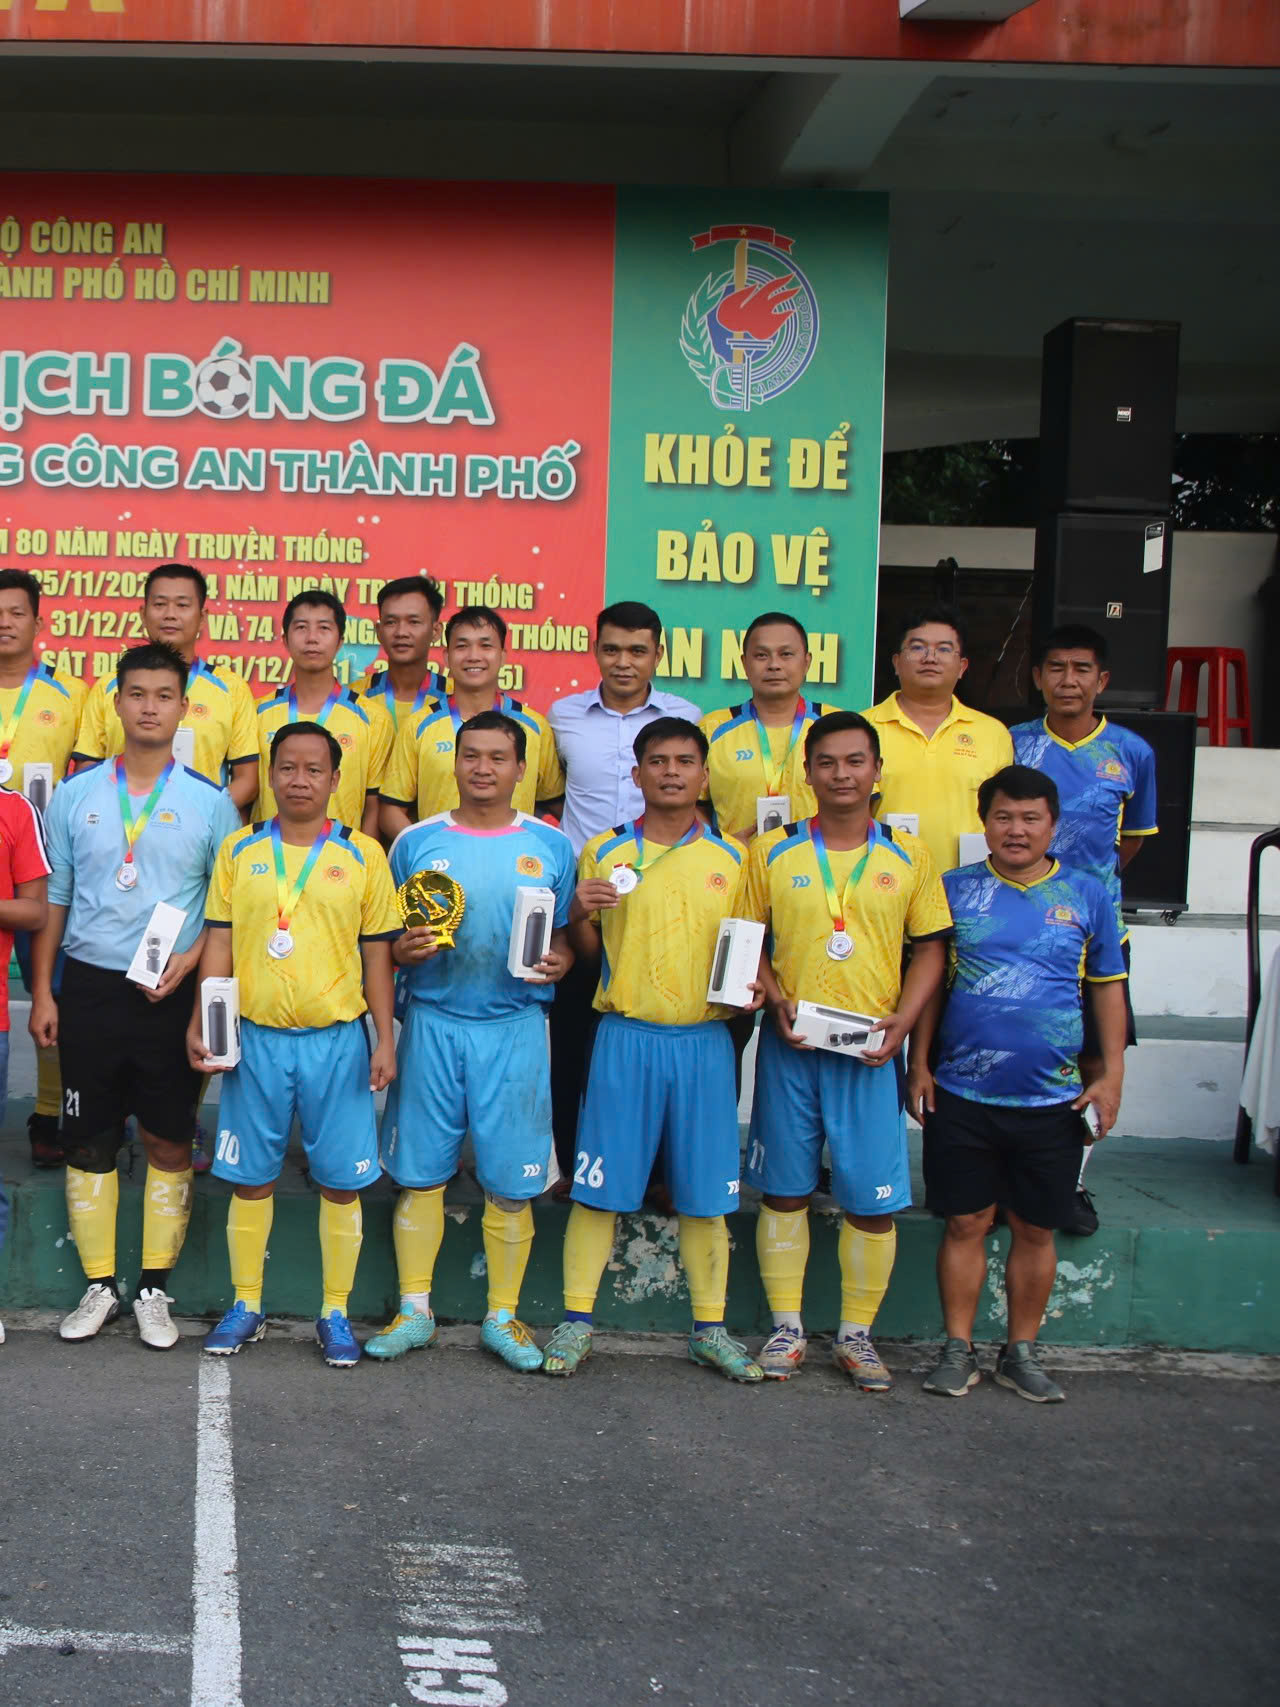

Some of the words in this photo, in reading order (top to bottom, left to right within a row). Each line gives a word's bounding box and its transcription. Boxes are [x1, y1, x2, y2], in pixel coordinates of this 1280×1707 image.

[30, 215, 113, 255] CÔNG
[123, 222, 163, 255] AN
[63, 256, 124, 300] PHỐ
[135, 257, 176, 301] HỒ
[186, 261, 239, 302] CHÍ
[249, 272, 330, 304] MINH
[375, 342, 496, 426] ĐÁ
[32, 432, 178, 489] CÔNG
[186, 446, 266, 492] AN
[270, 440, 457, 496] THÀNH
[465, 440, 581, 501] PHỐ
[644, 422, 771, 488] KHỎE
[787, 421, 851, 491] ĐỂ
[15, 528, 48, 556] 80
[55, 526, 109, 558] NĂM
[116, 528, 179, 559] NGÀY
[185, 526, 276, 562] TRUYỀN
[282, 526, 363, 564] THỐNG
[655, 519, 755, 584] BẢO
[771, 526, 830, 595] VỆ
[225, 570, 279, 602] NĂM
[453, 574, 534, 610] THỐNG
[207, 610, 240, 641] VÀ
[246, 614, 274, 642] 74
[508, 615, 589, 652] THỐNG
[216, 1129, 240, 1166] 10
[573, 1150, 604, 1189] 26
